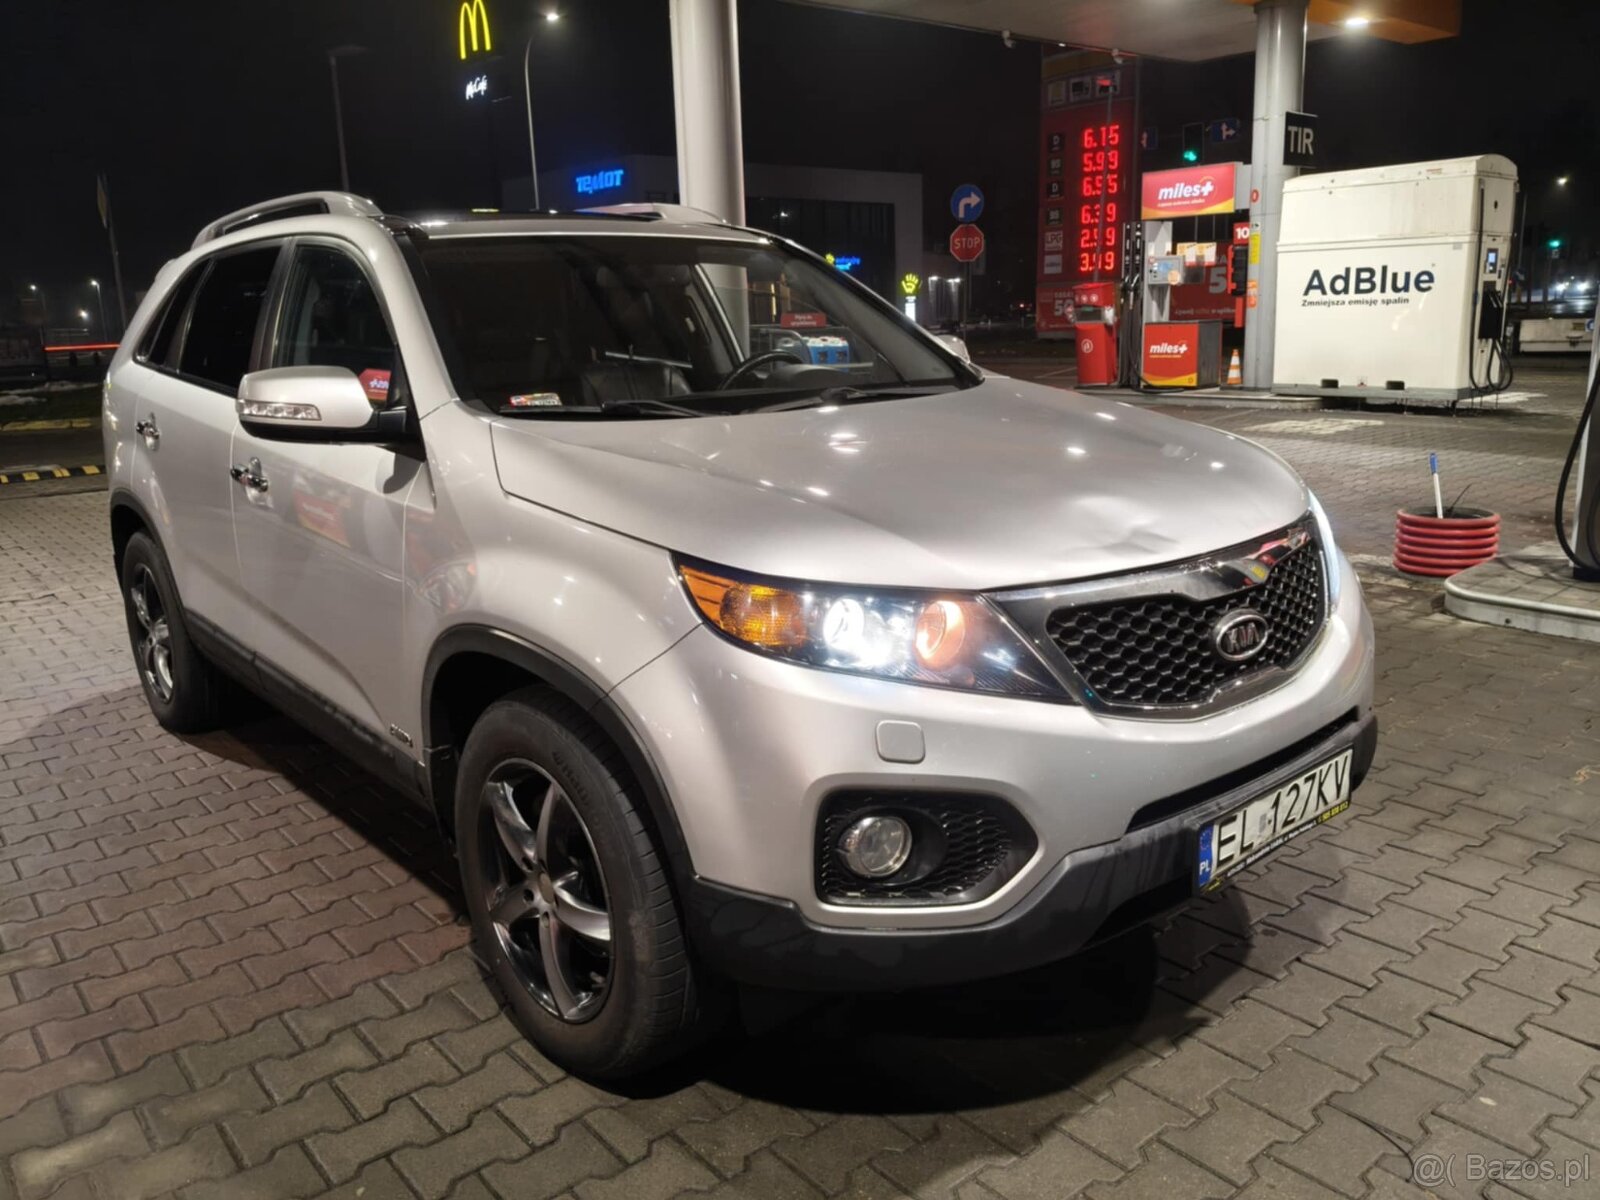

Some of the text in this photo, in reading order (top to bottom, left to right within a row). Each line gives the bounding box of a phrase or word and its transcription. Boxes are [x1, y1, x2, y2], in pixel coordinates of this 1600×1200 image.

[1084, 125, 1119, 149] 6.15
[1287, 126, 1314, 155] TIR
[1083, 150, 1118, 172] 5.99
[1158, 181, 1215, 200] miles+
[954, 237, 981, 250] STOP
[1302, 264, 1435, 297] AdBlue
[1301, 296, 1410, 308] Zmniejsza emisję spalin
[1149, 342, 1188, 354] miles+
[1226, 622, 1260, 653] KIA
[1216, 809, 1254, 868] EL
[1270, 755, 1349, 835] 127KV
[1200, 859, 1210, 876] PL
